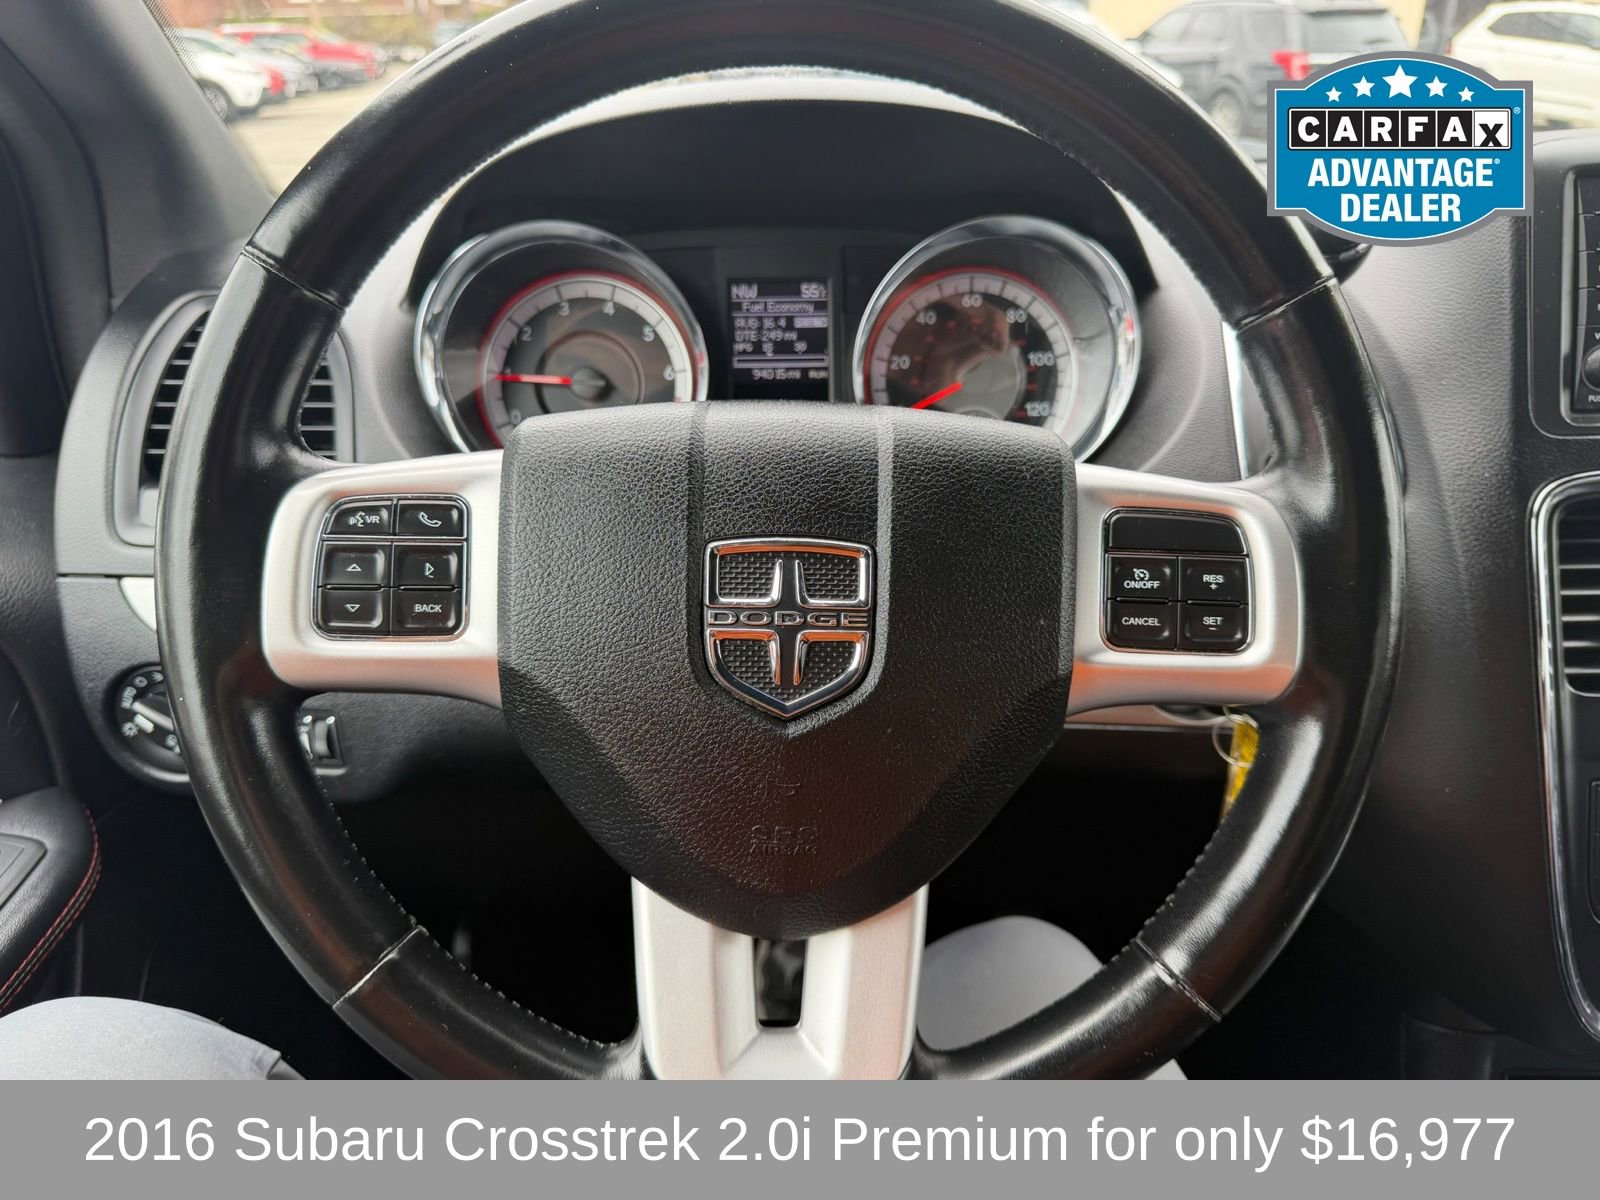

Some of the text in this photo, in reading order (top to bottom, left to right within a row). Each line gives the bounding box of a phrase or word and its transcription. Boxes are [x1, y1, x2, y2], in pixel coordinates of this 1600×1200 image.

[731, 283, 758, 299] NW
[557, 301, 571, 316] 3
[742, 302, 815, 314] Fuel Economy
[961, 294, 983, 308] 60
[602, 301, 616, 317] 4
[1006, 306, 1028, 323] 80
[916, 310, 938, 325] 40
[520, 325, 533, 341] 2
[642, 325, 655, 342] 5
[889, 355, 912, 370] 20
[1027, 350, 1056, 366] 100
[663, 364, 675, 380] 6
[1025, 401, 1051, 417] 120
[365, 515, 380, 524] VR
[1123, 580, 1161, 589] ON/OFF
[1202, 574, 1224, 583] RES
[414, 604, 442, 613] BACK
[707, 610, 869, 628] DODGE
[1121, 617, 1161, 626] CANCEL
[1202, 616, 1223, 625] SET
